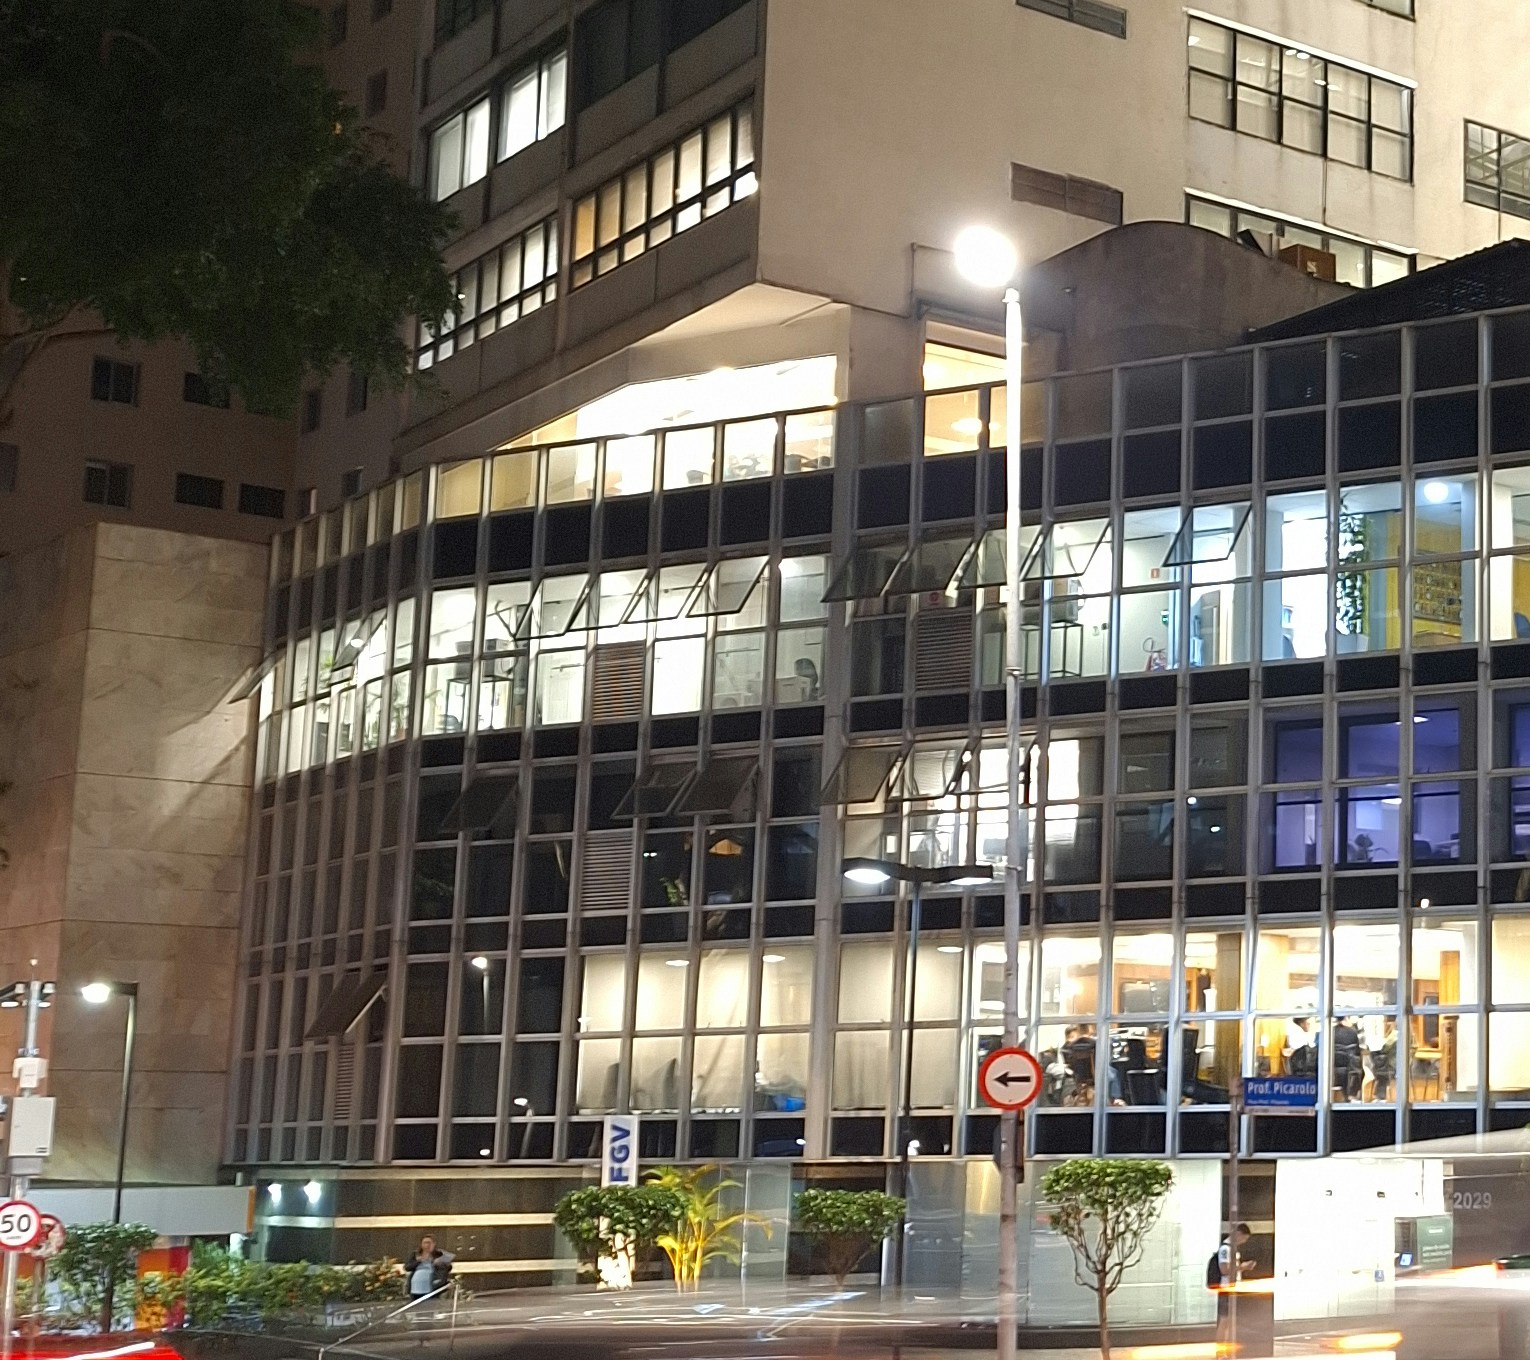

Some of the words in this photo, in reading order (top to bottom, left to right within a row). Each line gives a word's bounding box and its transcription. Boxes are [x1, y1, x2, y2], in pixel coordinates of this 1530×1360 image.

[1247, 1081, 1271, 1095] Prof.
[609, 1124, 631, 1182] FGV
[1453, 1192, 1492, 1209] 2029
[0, 1213, 31, 1234] 50
